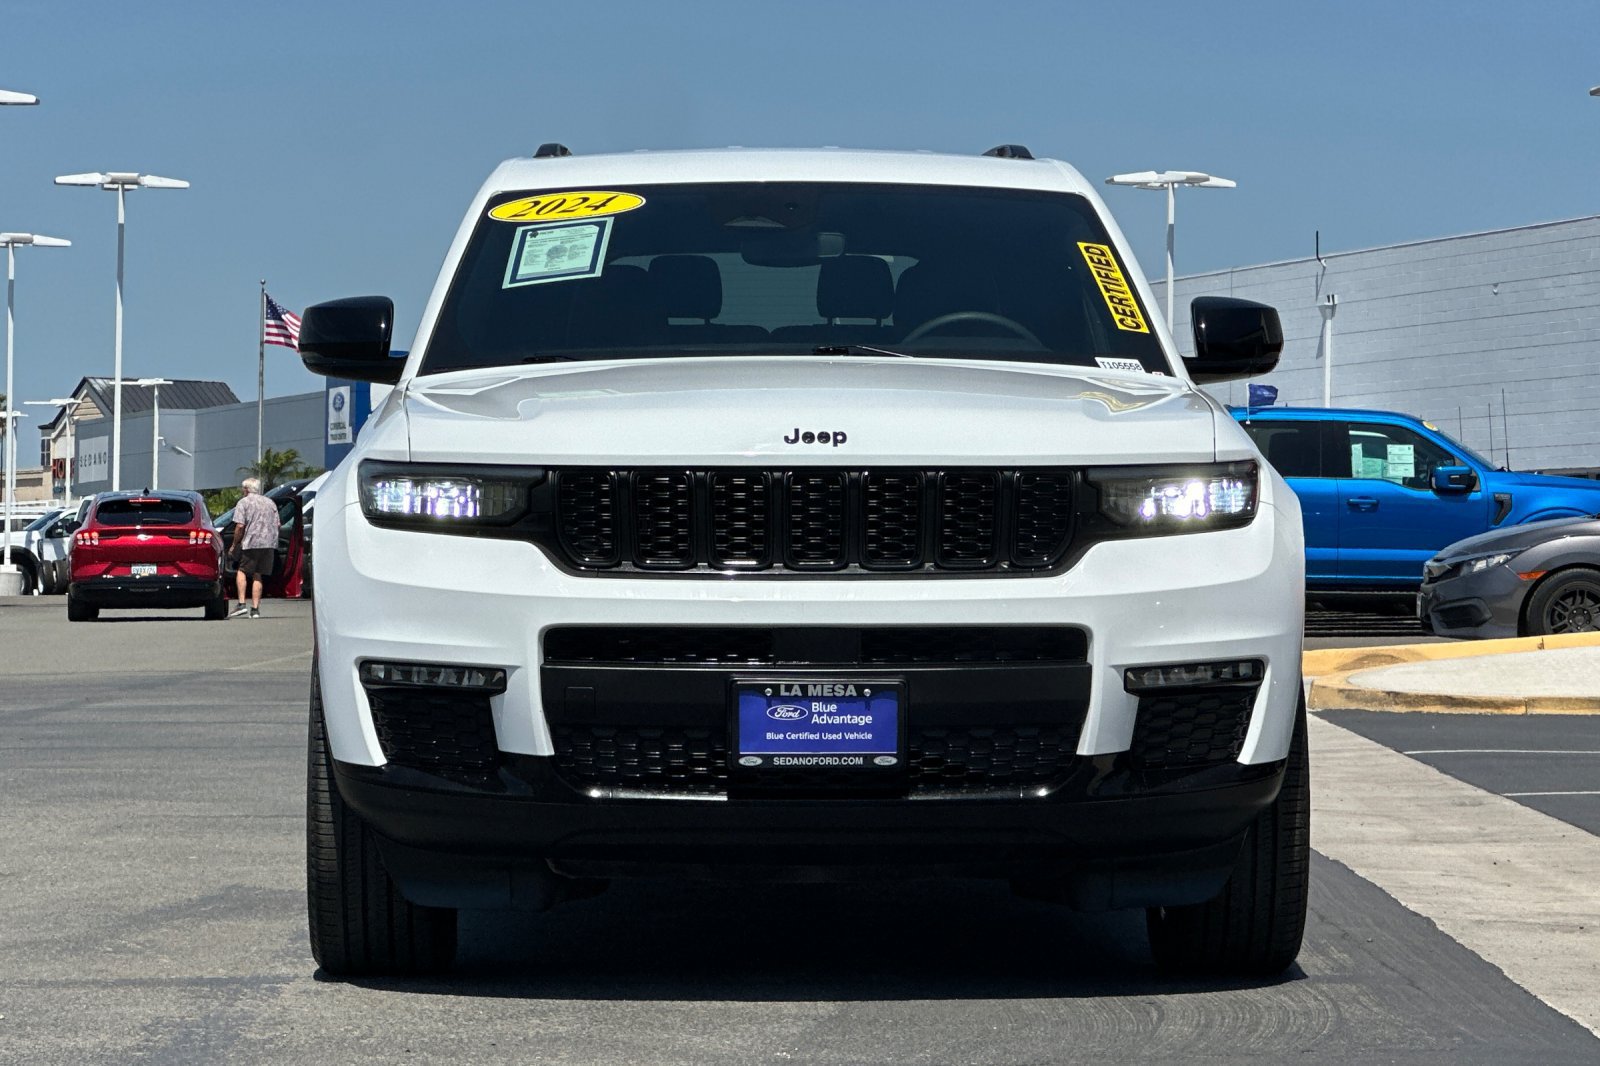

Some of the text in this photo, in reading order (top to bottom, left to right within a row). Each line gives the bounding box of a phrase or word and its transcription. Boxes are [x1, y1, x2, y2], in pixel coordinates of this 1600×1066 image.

[507, 194, 620, 218] 2024
[1083, 245, 1142, 330] CERTIFIED
[1100, 361, 1142, 371] T105558
[783, 428, 847, 447] Jeep
[79, 451, 107, 468] SEDANO
[780, 684, 857, 697] LA MESA
[811, 702, 837, 713] Blue
[811, 713, 873, 725] Advantage
[766, 732, 873, 740] Blue Certified Used Vehicle
[773, 757, 864, 766] SEDANOFORD.COM
